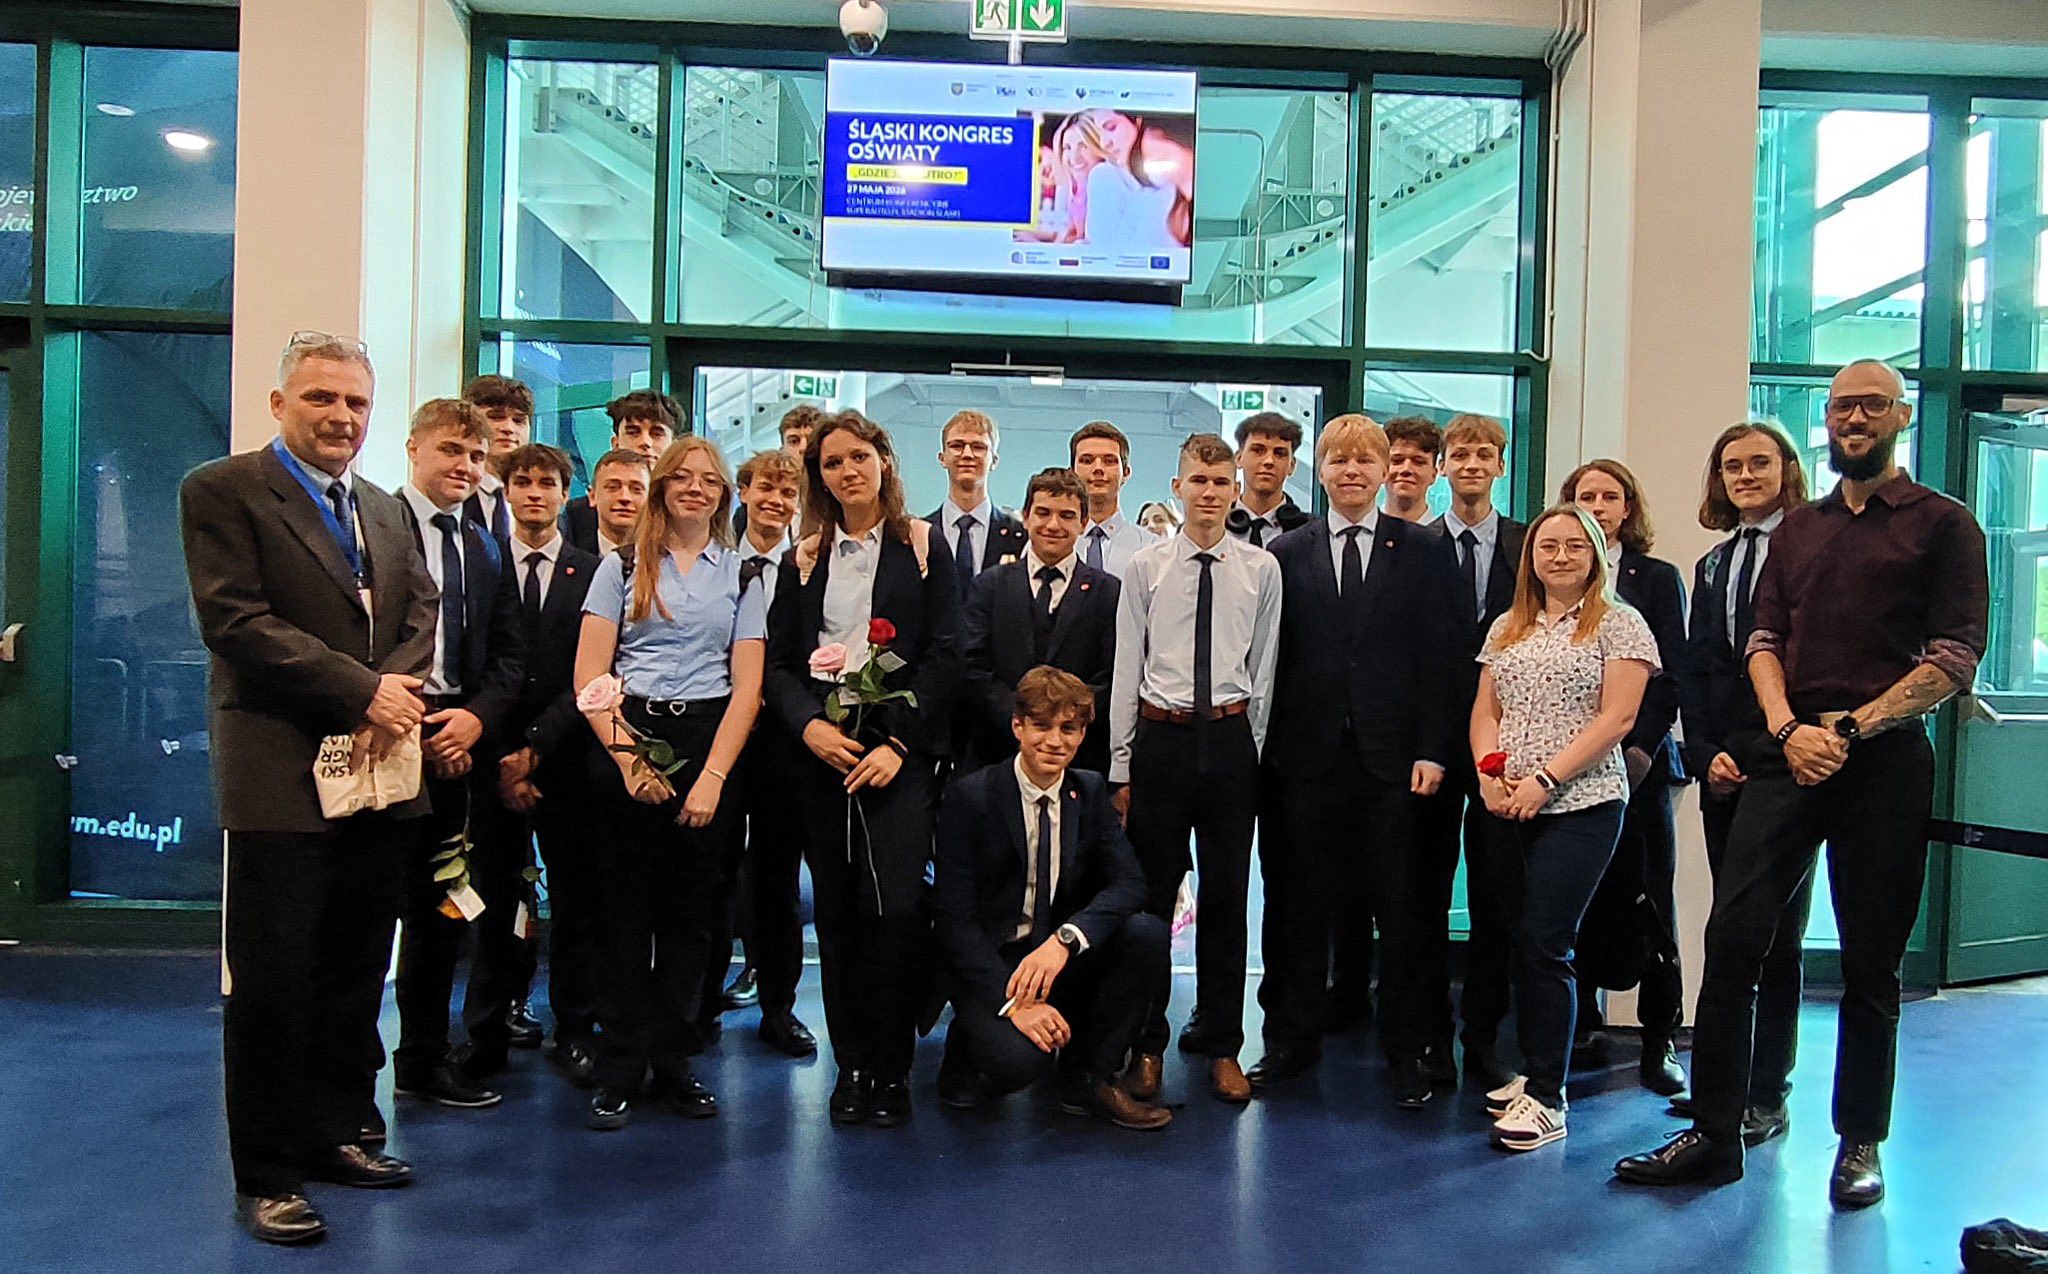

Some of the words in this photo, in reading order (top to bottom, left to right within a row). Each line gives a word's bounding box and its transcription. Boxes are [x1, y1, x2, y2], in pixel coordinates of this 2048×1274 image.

[848, 118, 915, 143] ŚLĄSKI
[919, 123, 1014, 145] KONGRES
[847, 140, 941, 162] OŚWIATY
[859, 184, 885, 195] MAJA
